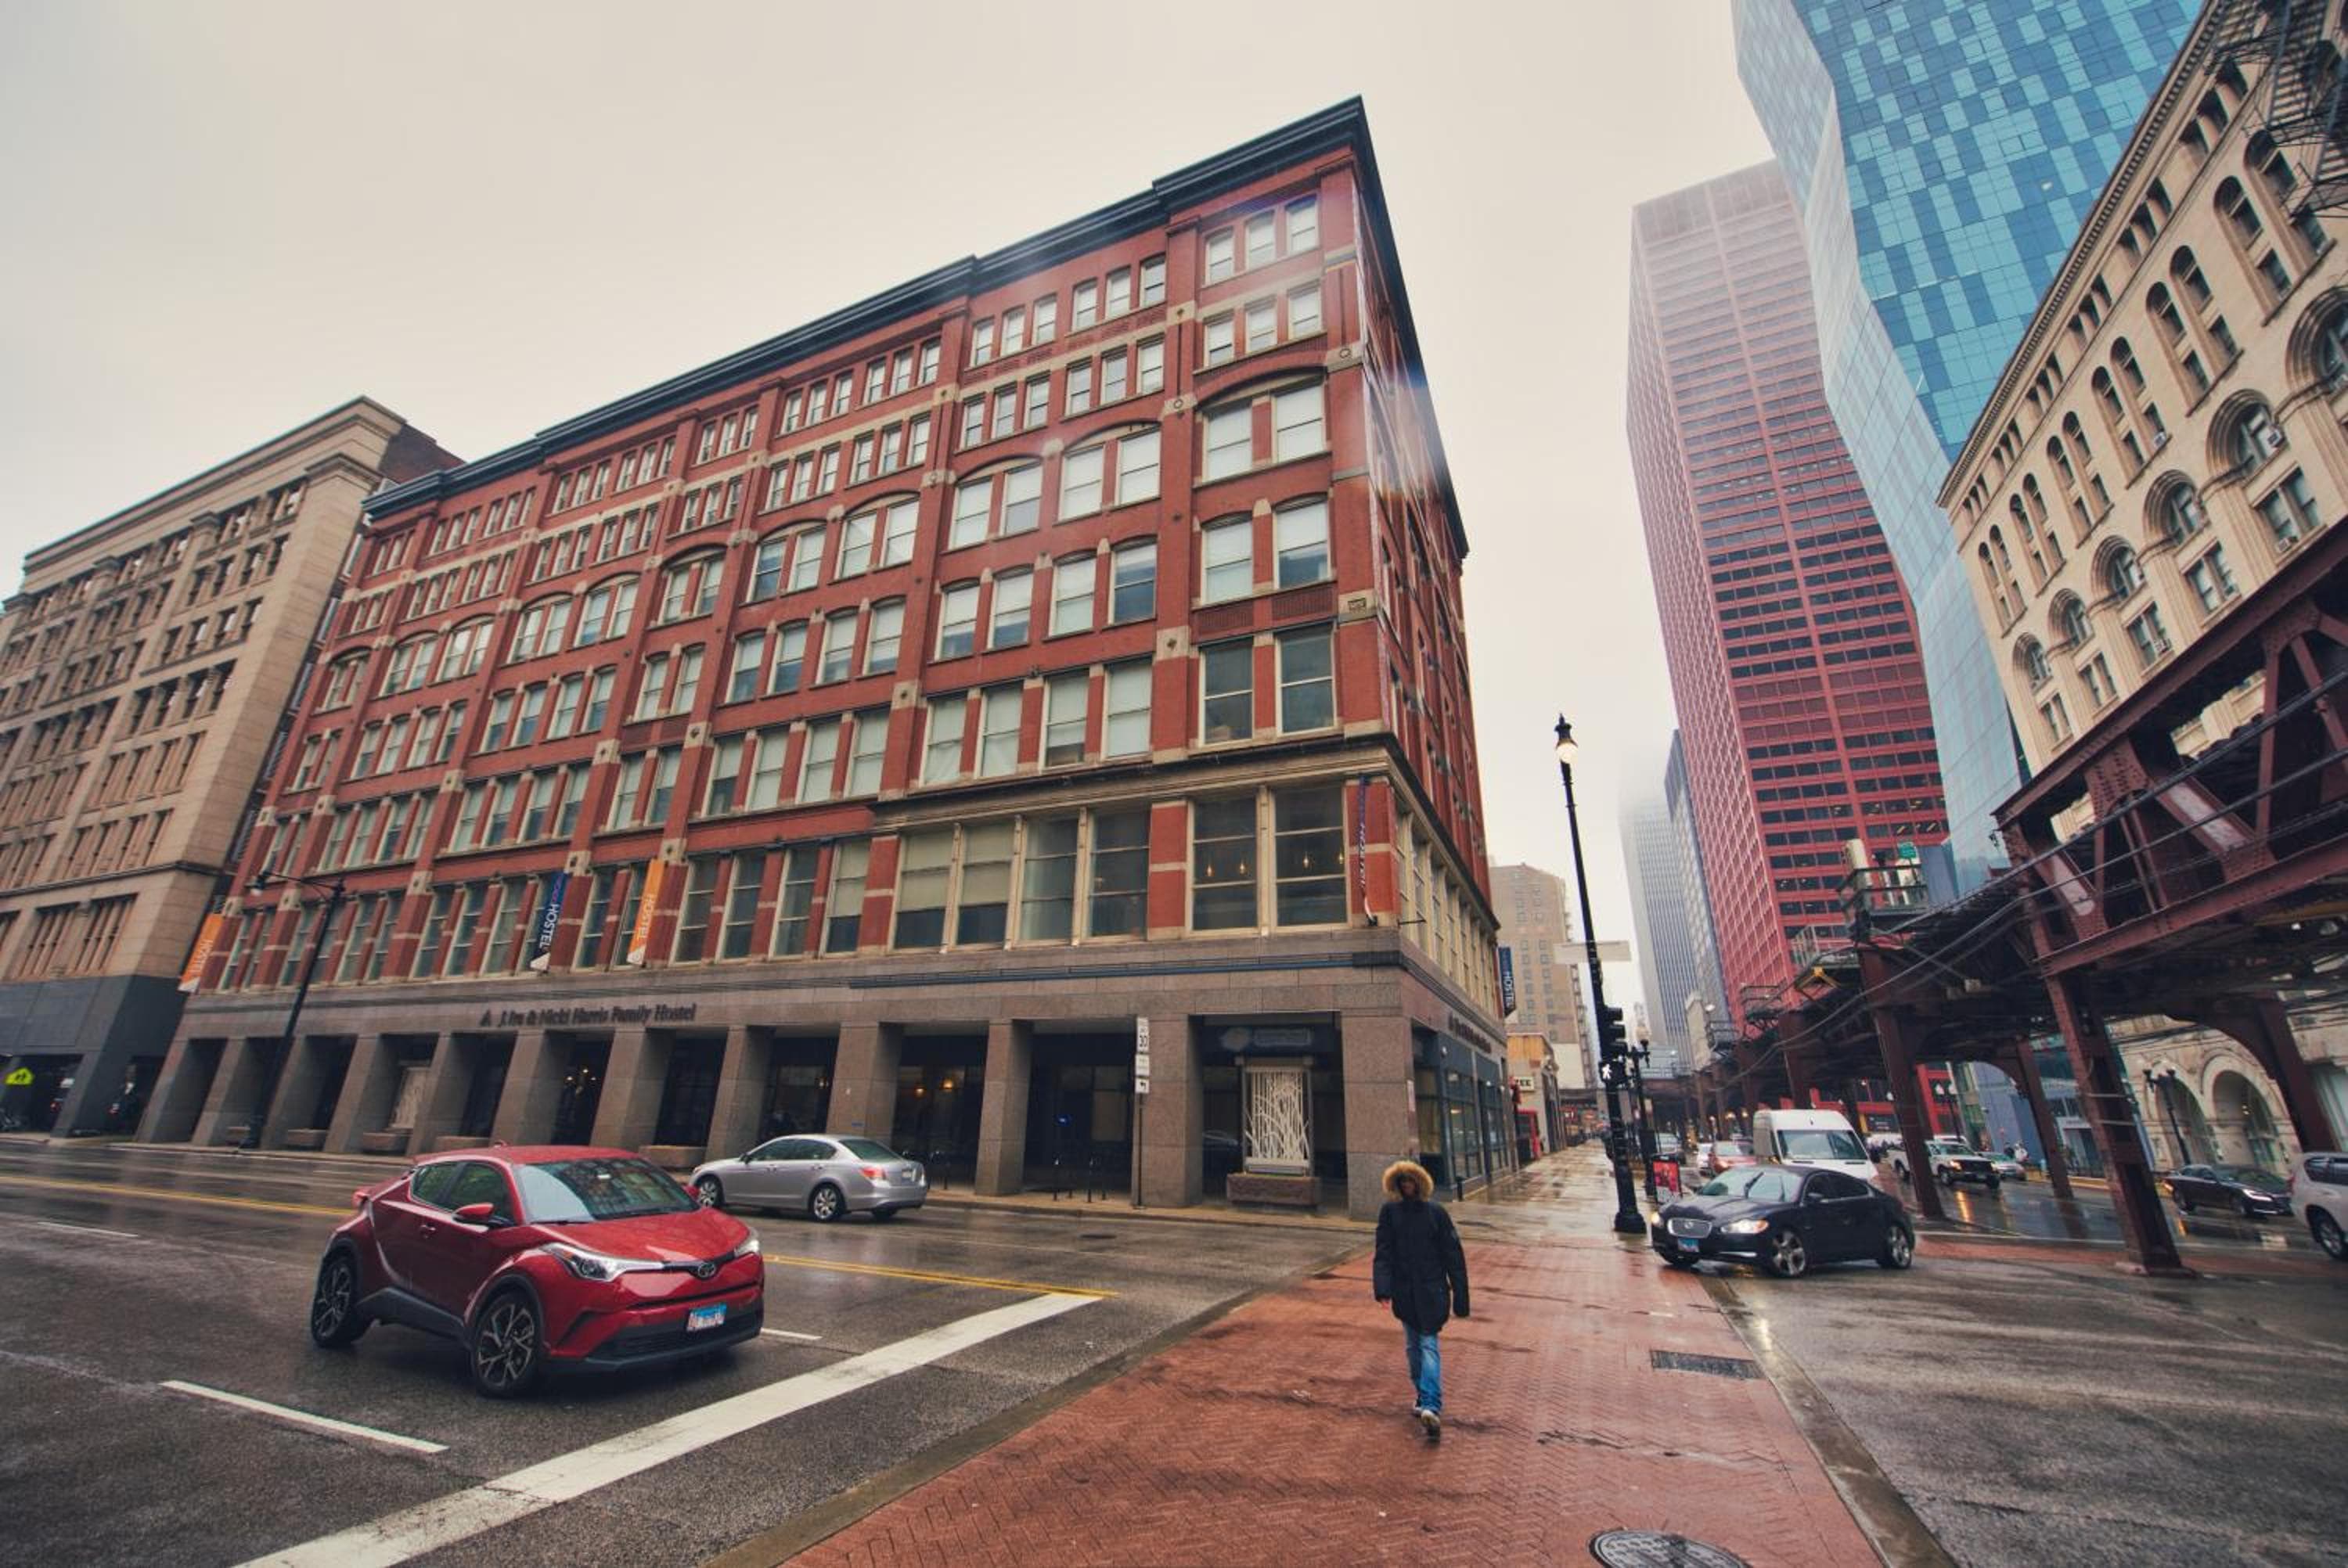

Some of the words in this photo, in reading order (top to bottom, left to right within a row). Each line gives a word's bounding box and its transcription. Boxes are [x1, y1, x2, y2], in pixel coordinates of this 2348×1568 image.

[539, 904, 560, 949] HOSTEL
[1503, 971, 1514, 1008] HOSTEL
[611, 1005, 652, 1026] Family
[654, 1002, 697, 1021] Hostel
